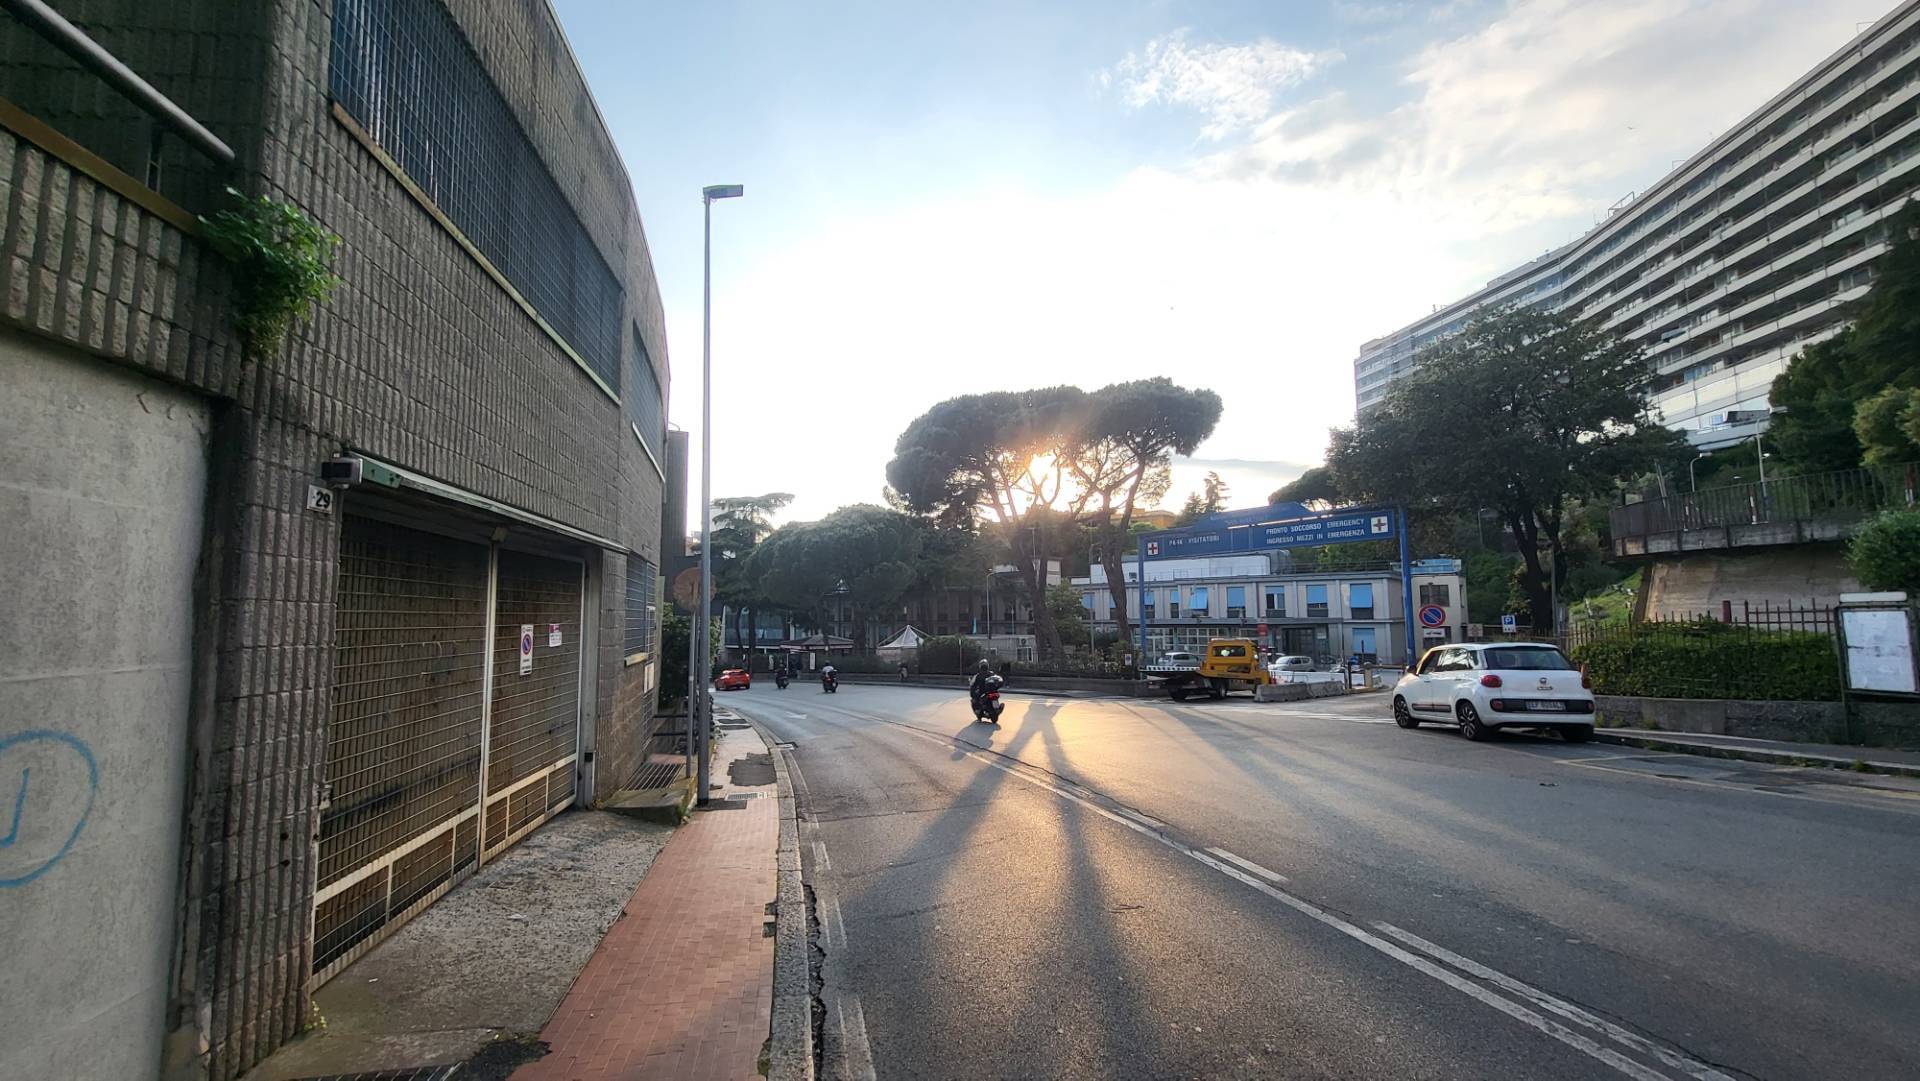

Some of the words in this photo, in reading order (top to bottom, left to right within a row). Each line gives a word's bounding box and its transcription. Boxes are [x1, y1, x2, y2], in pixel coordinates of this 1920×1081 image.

[316, 490, 331, 509] 29
[1266, 526, 1288, 535] PRONTO
[1290, 523, 1322, 533] SOCCORSO
[1326, 518, 1365, 529] EMERGENCY
[1188, 535, 1220, 544] VISITATORI
[1266, 536, 1294, 545] INGRESSO
[1296, 534, 1314, 542] MEZZI
[1327, 529, 1365, 539] EMERGENZA
